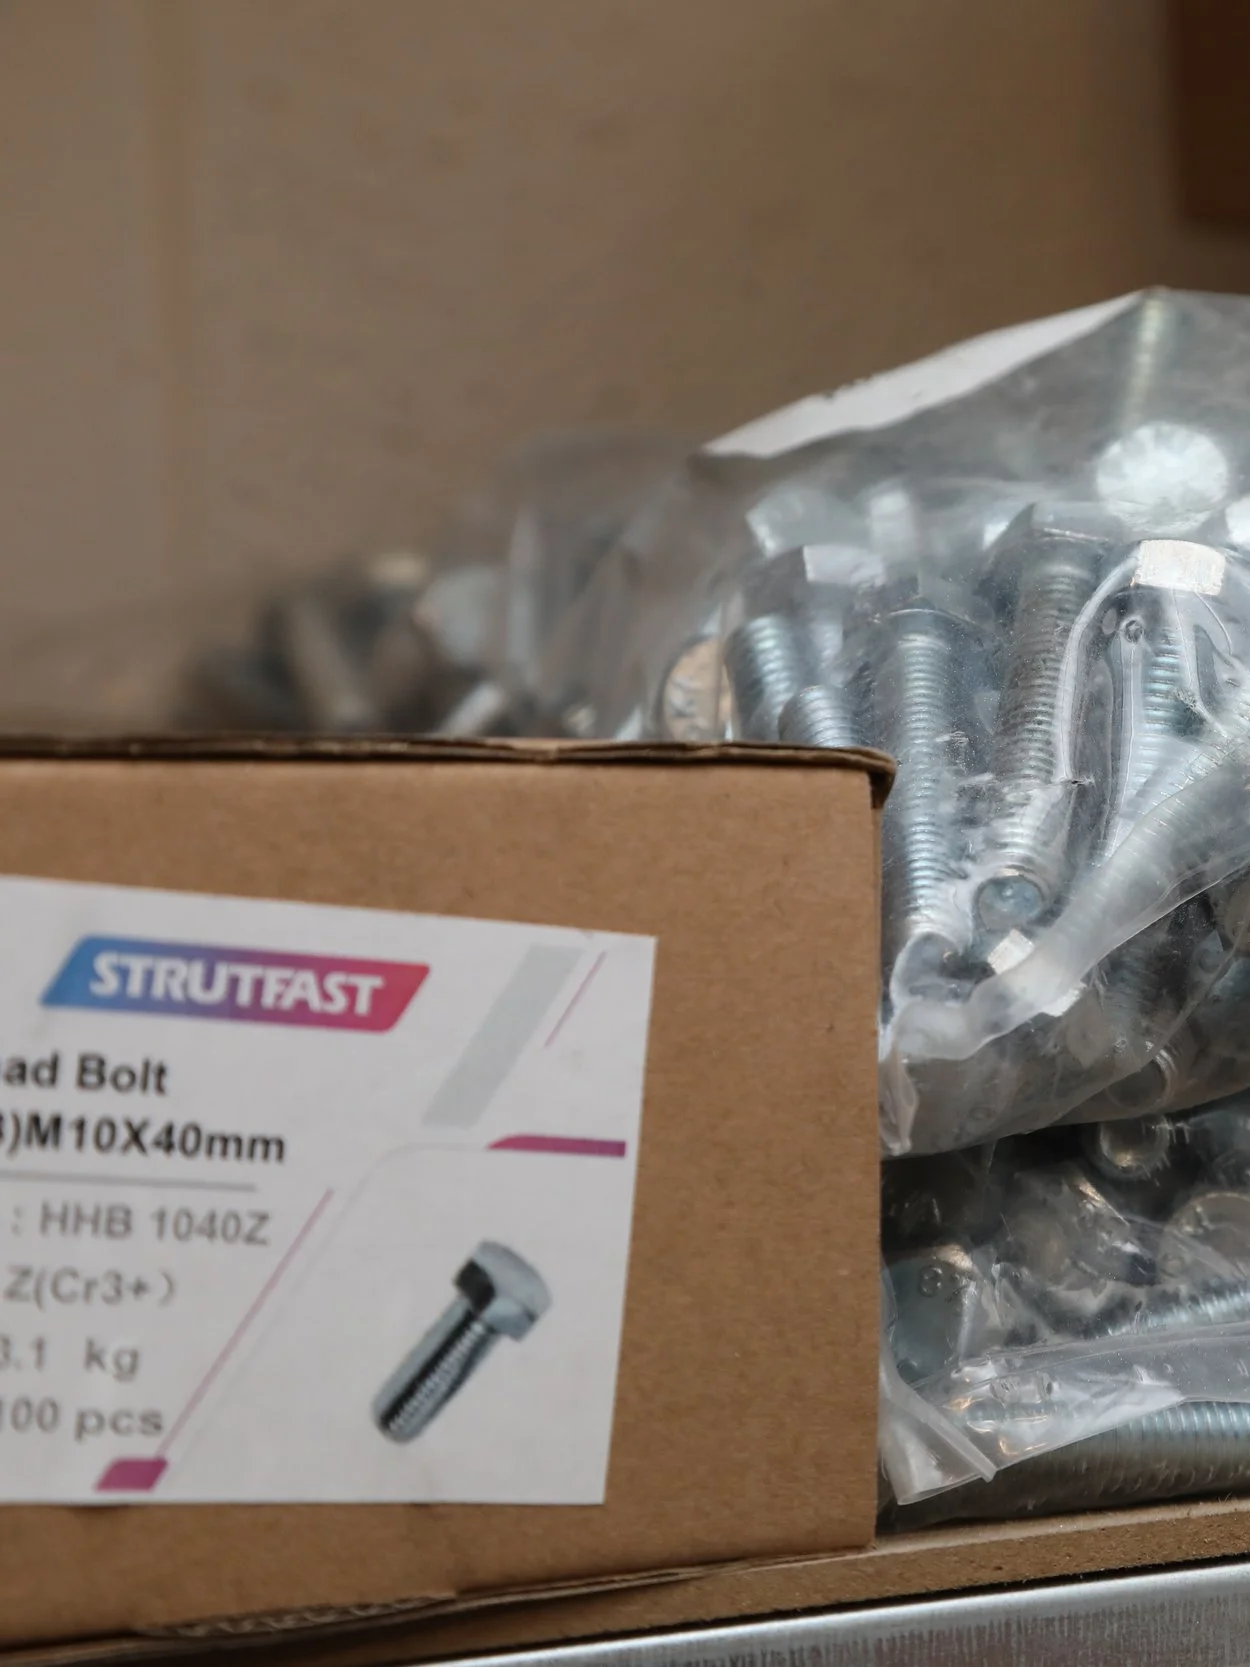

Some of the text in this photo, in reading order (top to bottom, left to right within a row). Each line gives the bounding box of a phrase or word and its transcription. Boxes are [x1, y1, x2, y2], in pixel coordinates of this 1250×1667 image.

[90, 952, 384, 1017] STRUTFAST
[76, 1053, 168, 1096] Bolt
[0, 1110, 286, 1164] )M10X40mm
[39, 1203, 133, 1240] HHB
[150, 1206, 270, 1246] 1040Z
[84, 1337, 140, 1382] kg
[74, 1408, 164, 1442] pcs
